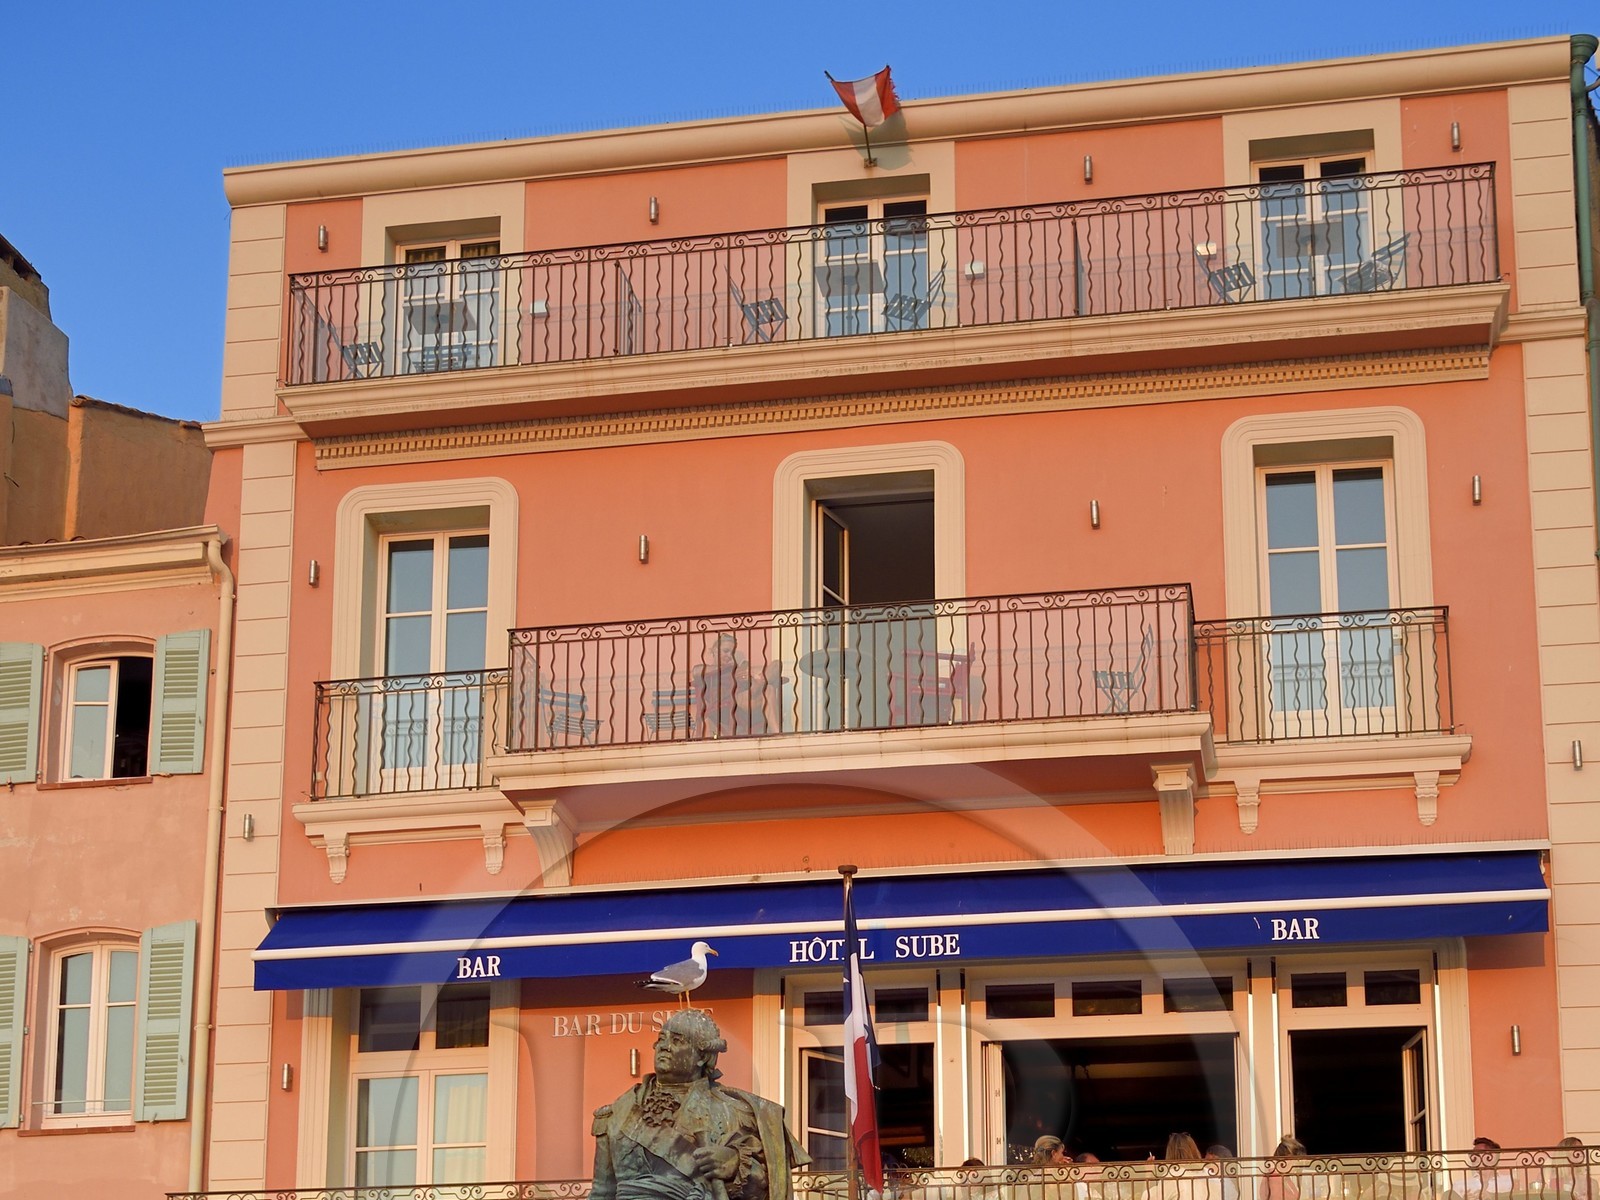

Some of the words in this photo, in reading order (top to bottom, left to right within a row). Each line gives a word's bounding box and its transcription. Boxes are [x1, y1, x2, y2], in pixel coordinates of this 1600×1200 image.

[1271, 917, 1320, 940] BAR
[789, 936, 875, 962] HÔTL
[895, 933, 961, 958] SUBE
[456, 955, 501, 978] BAR
[552, 1012, 602, 1037] BAR
[610, 1011, 645, 1034] DU
